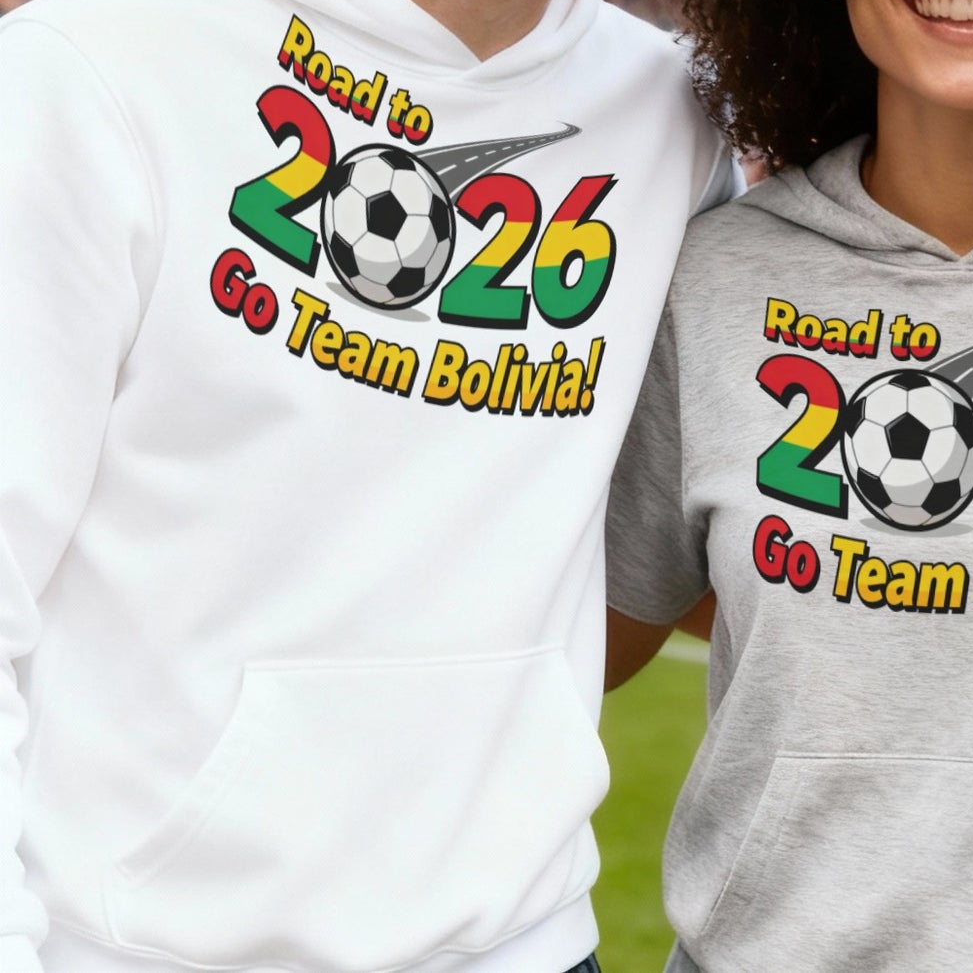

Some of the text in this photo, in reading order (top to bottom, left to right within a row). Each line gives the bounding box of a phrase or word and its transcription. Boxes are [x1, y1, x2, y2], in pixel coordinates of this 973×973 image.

[278, 13, 434, 146] Road to
[210, 247, 605, 418] Go Team Bolivia!
[763, 297, 942, 361] Road to
[752, 514, 821, 594] Go
[830, 534, 969, 615] Team
